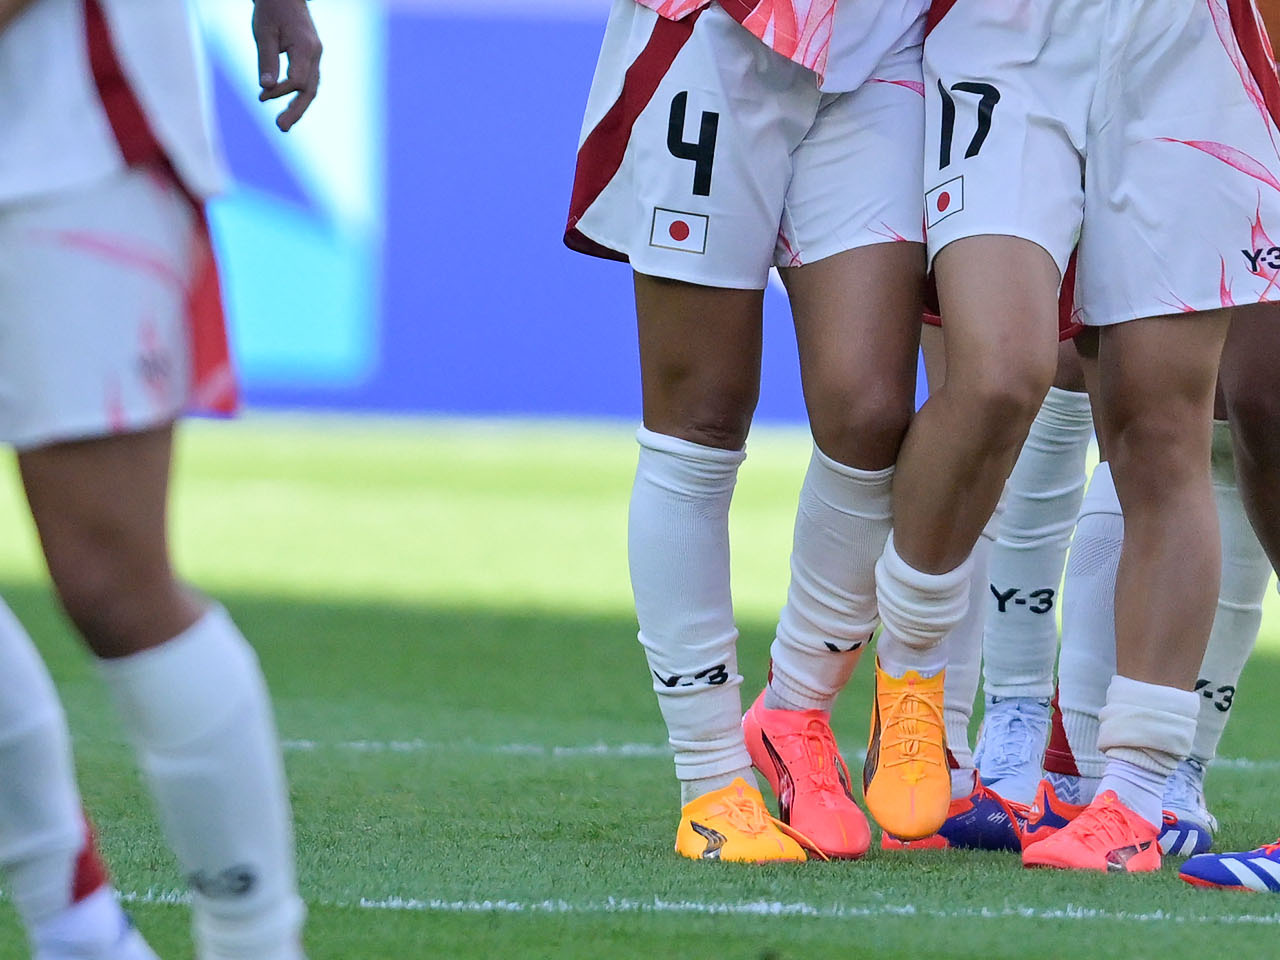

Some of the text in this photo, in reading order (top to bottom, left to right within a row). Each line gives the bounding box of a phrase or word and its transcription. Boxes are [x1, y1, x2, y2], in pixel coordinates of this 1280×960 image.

[667, 90, 720, 197] 4
[938, 77, 1002, 171] 17
[990, 583, 1055, 615] Y-3
